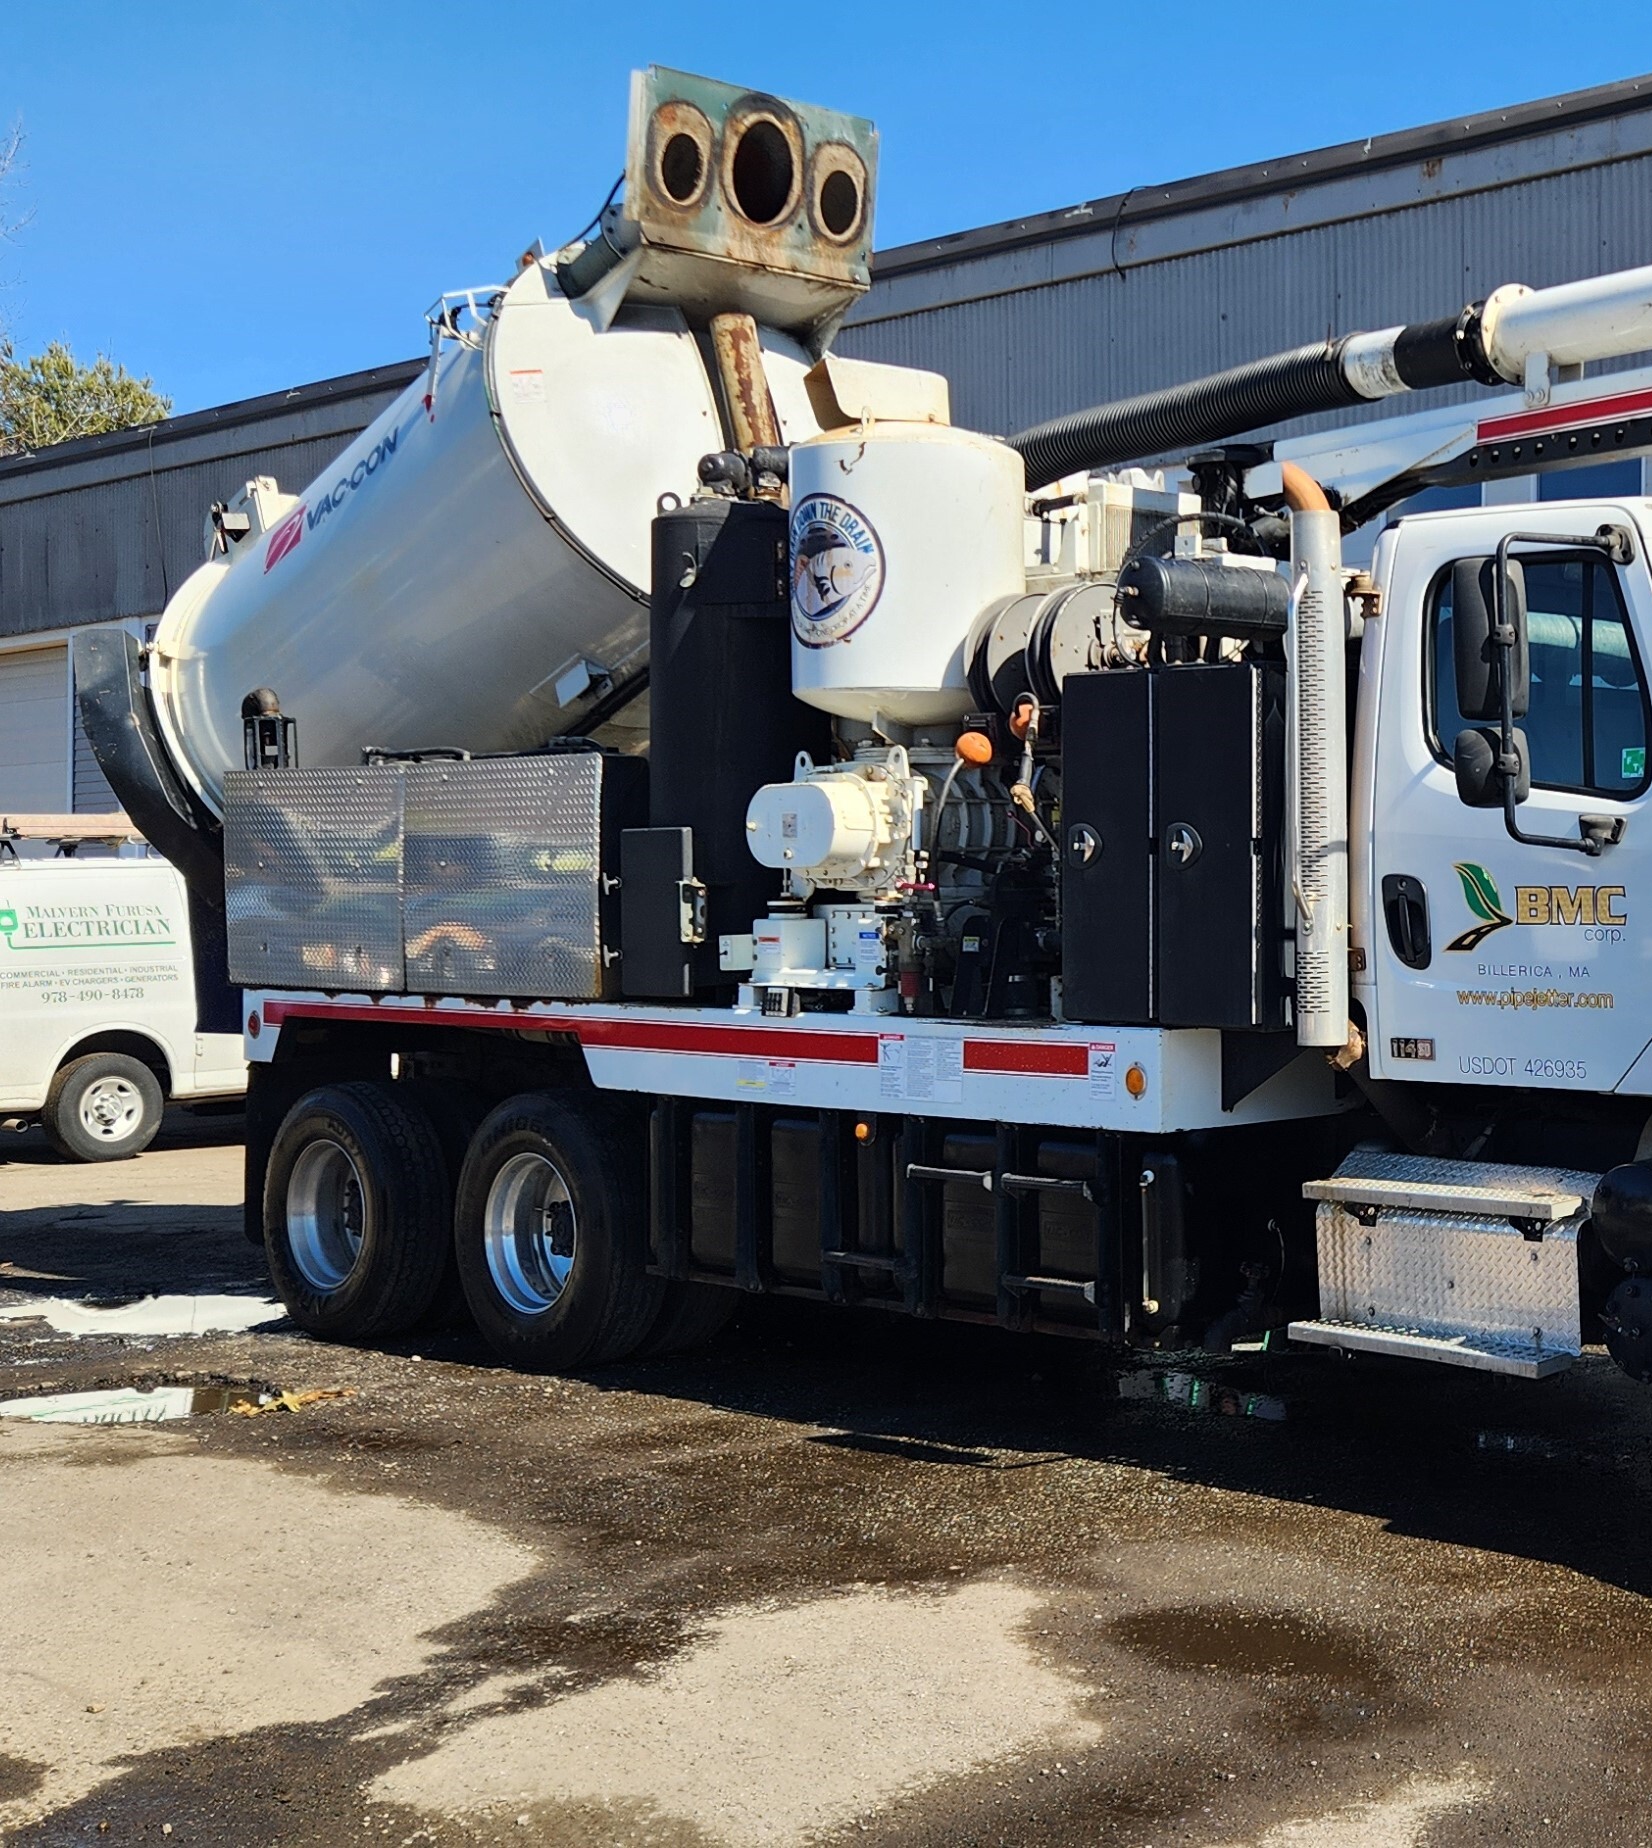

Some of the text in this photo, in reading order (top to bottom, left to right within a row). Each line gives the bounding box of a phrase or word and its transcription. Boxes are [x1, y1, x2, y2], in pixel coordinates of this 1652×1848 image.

[820, 502, 841, 522] THE
[839, 513, 874, 554] DRAIN
[26, 905, 98, 919] MALVERN
[1515, 886, 1627, 925] BMC
[24, 919, 171, 938] ELECTRICIAN
[1584, 927, 1626, 945] corp.
[0, 965, 178, 979] COMMERCIAL RESIDENTIAL INDUSTRIAL
[1569, 966, 1590, 978] MA
[1, 981, 20, 989] FIRE
[22, 980, 52, 988] ALARM
[73, 976, 118, 985] CHARGERS
[125, 974, 179, 983] GENERATORS
[41, 987, 144, 1003] 978-490-8478
[1456, 987, 1614, 1011] www.pipejetter.com
[1459, 1056, 1587, 1079] USDOT 426935
